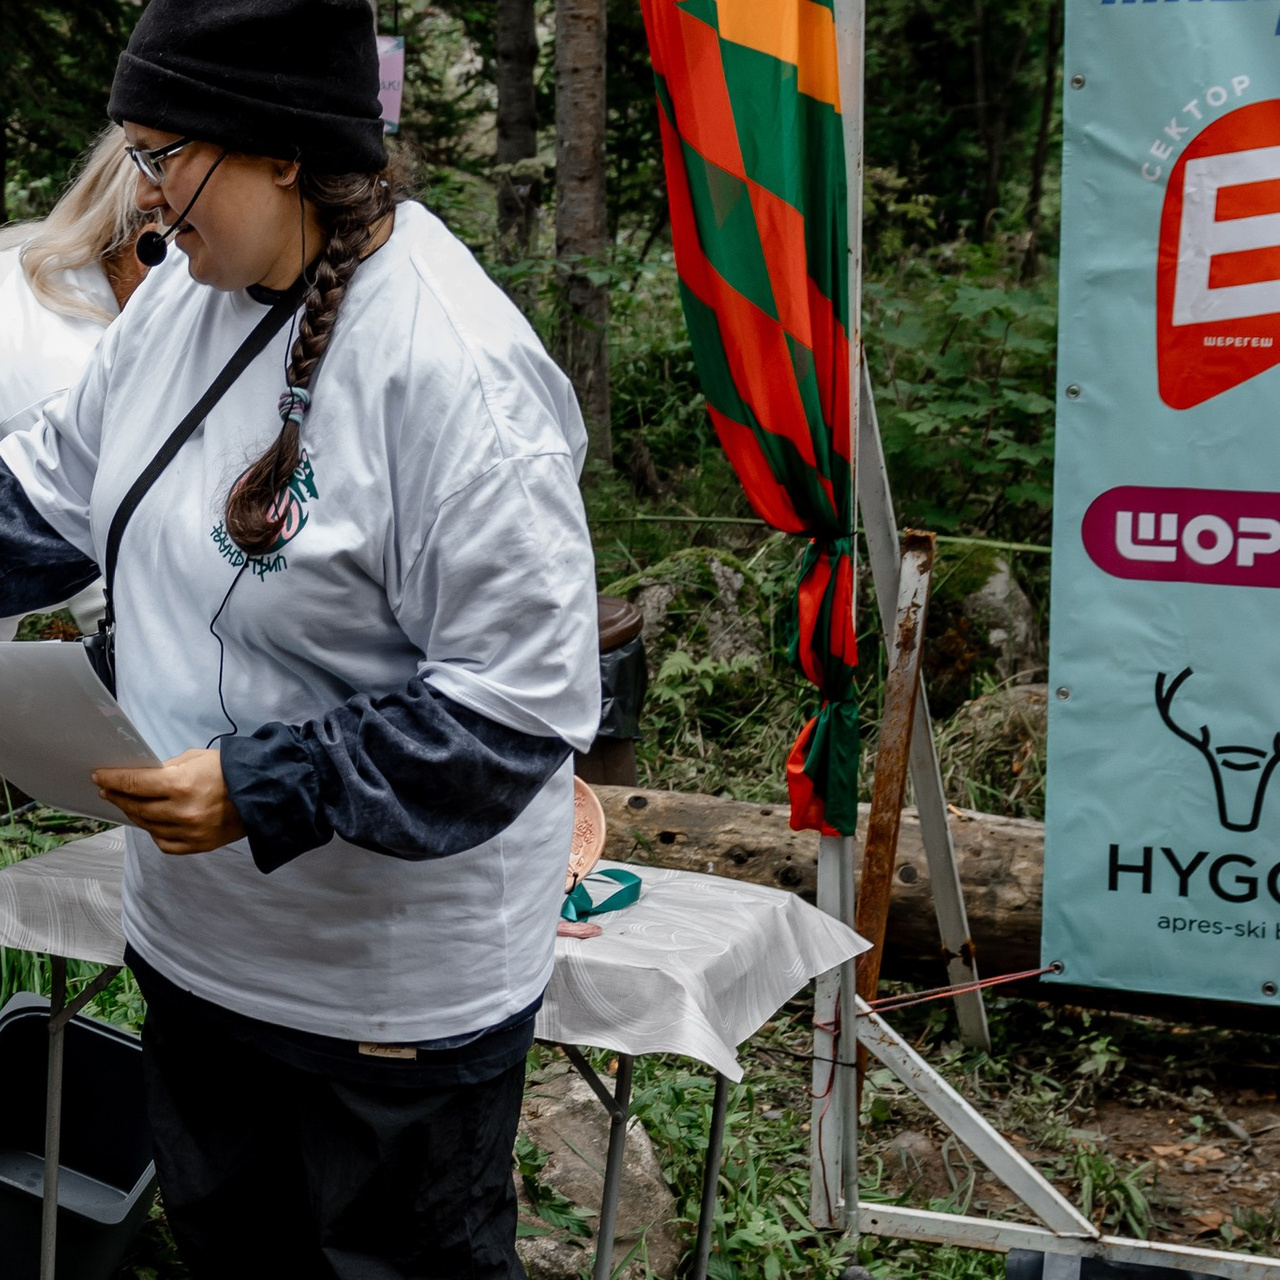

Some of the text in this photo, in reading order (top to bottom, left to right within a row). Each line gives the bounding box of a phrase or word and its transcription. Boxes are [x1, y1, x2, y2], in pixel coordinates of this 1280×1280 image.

[1141, 74, 1251, 182] СЕКТОР
[1203, 336, 1273, 348] ШЕРЕГЕШ
[1115, 510, 1280, 567] ШОР
[1157, 915, 1267, 939] apres-ski
